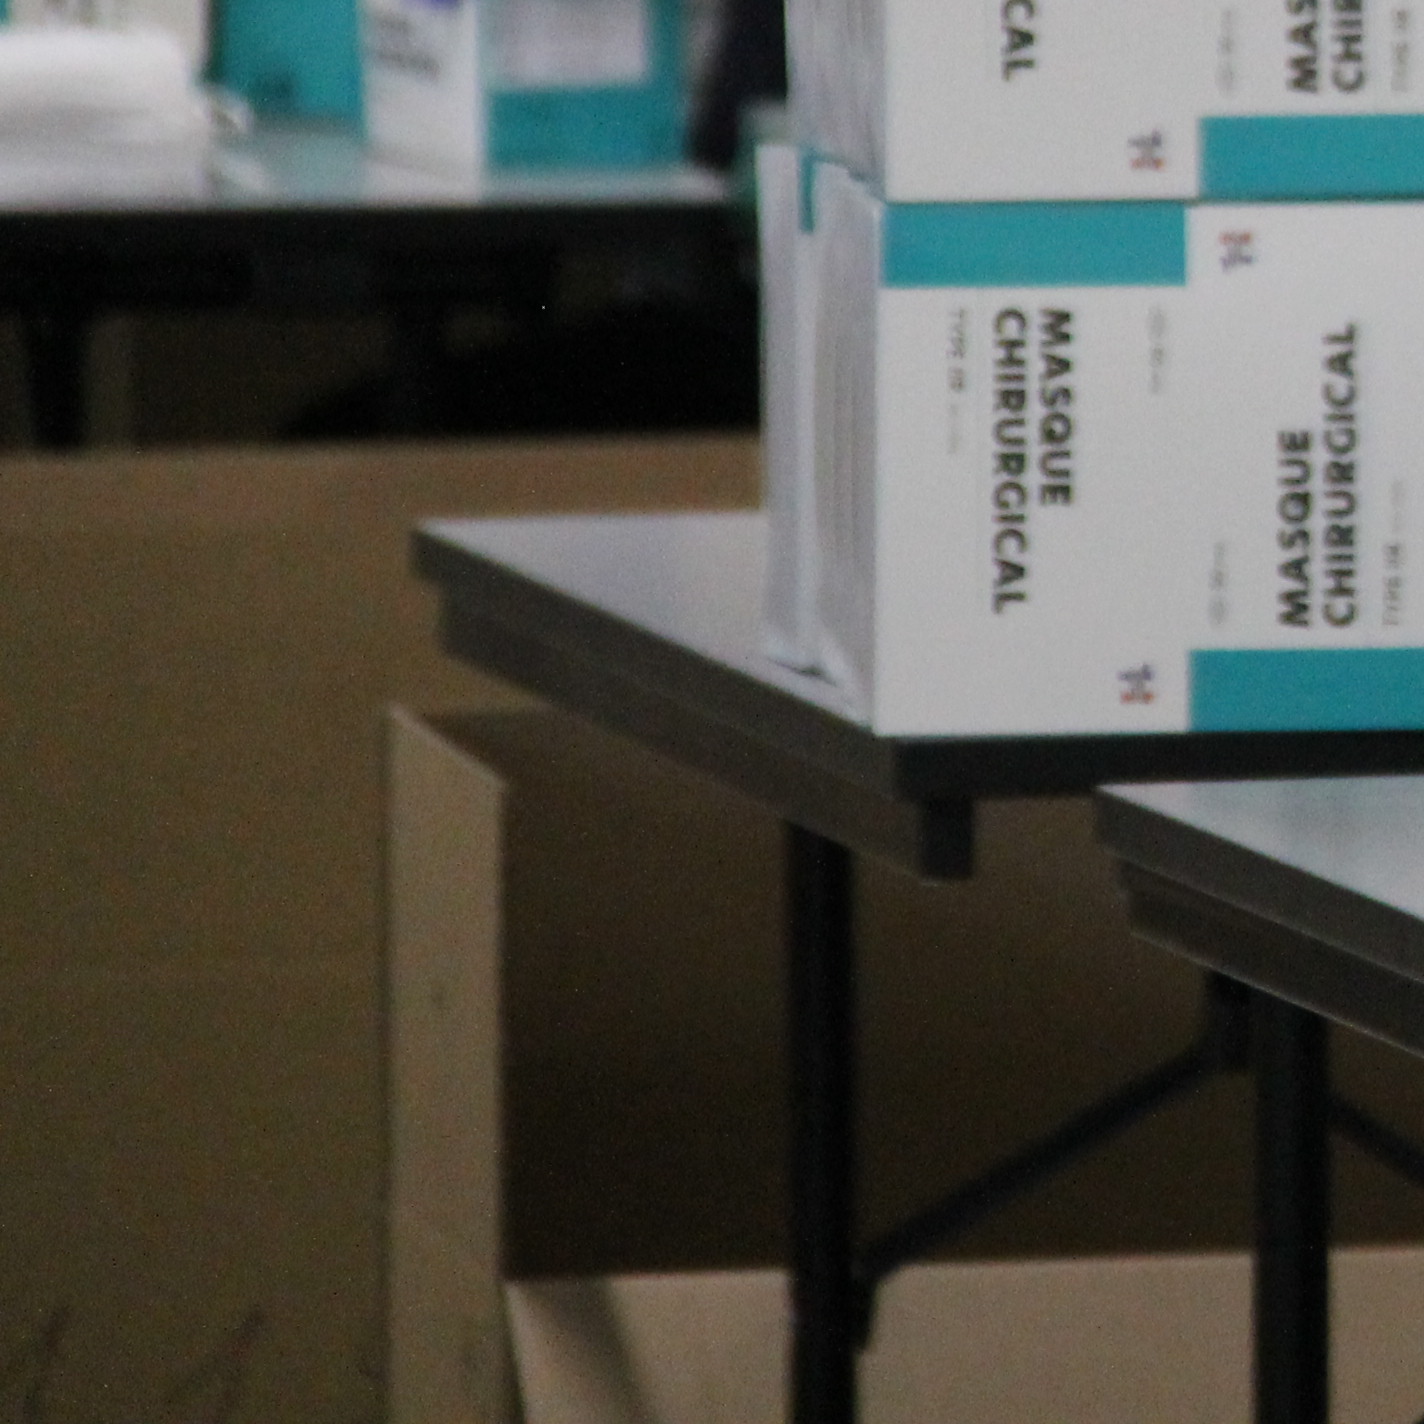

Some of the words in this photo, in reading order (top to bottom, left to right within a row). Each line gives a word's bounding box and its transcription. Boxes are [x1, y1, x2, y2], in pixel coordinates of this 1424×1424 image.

[992, 307, 1029, 613] CHIRURGICAL
[1039, 308, 1074, 505] MASQUE
[1278, 430, 1315, 629] MASQUE
[1322, 325, 1358, 629] CHIRURGICAL
